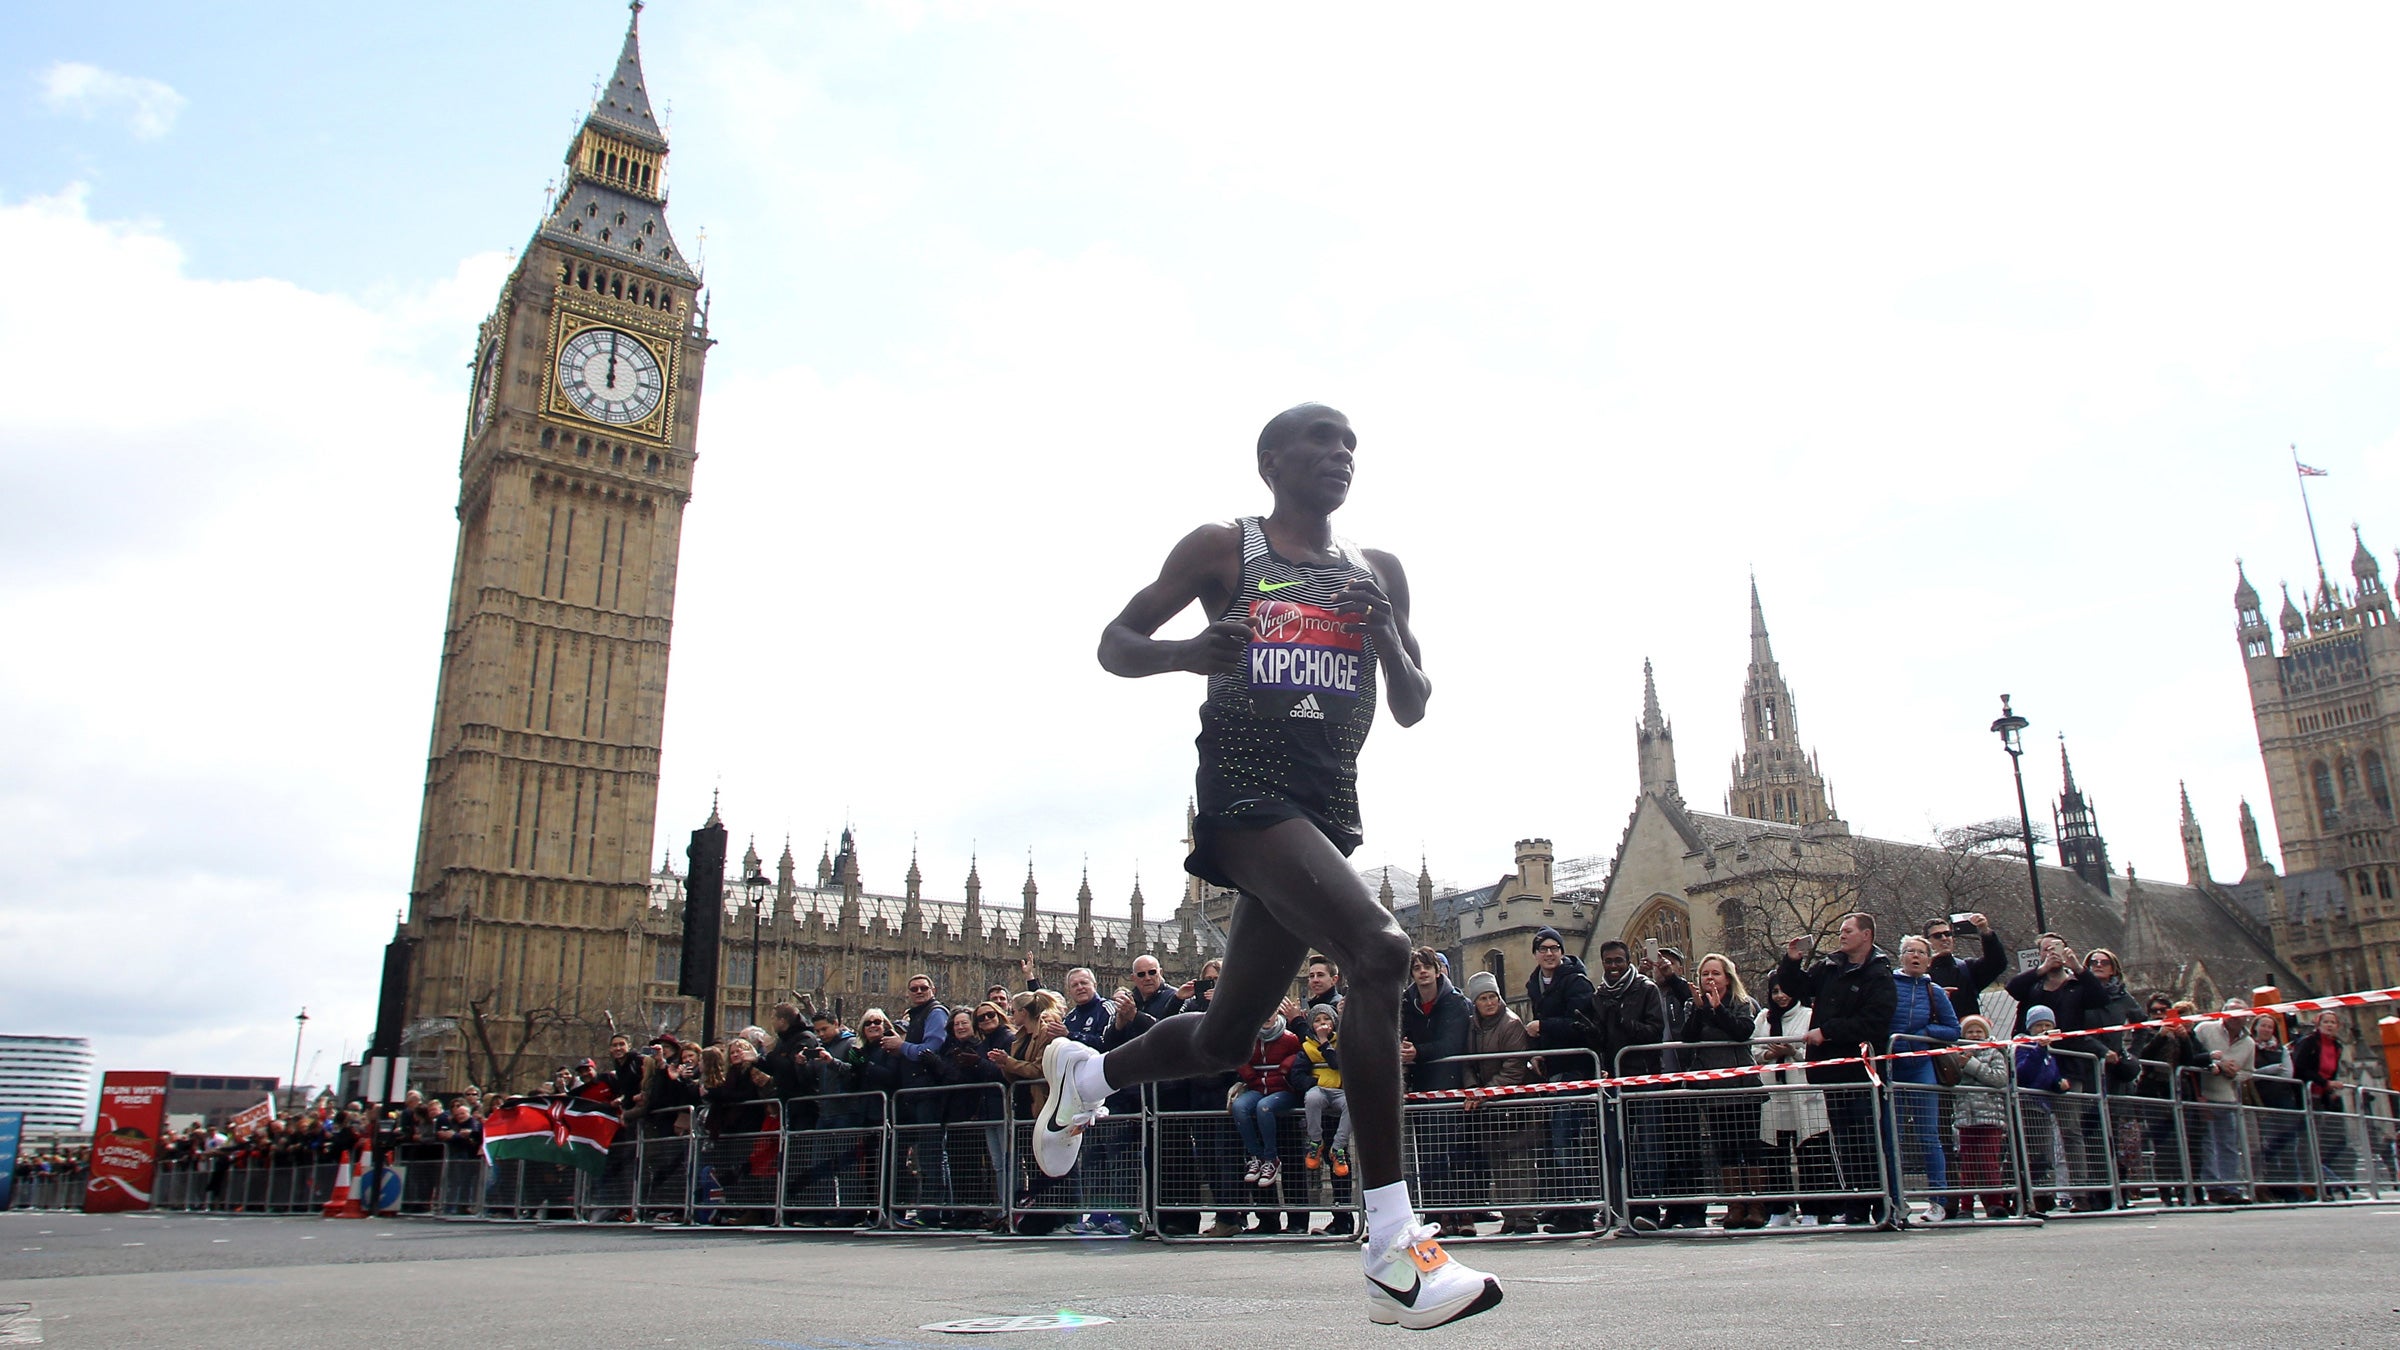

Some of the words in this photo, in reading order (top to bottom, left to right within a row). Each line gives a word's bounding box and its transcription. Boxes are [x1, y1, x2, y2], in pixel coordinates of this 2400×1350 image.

[1260, 601, 1300, 639] Virgin
[1305, 617, 1354, 639] mone
[1252, 648, 1359, 692] KIPCHOGE
[1289, 708, 1325, 720] adidas
[103, 1086, 130, 1095] RUN
[132, 1086, 166, 1095] WITH
[114, 1095, 153, 1104] PRIDE
[97, 1146, 150, 1163] LONDON
[101, 1156, 140, 1169] PRIDE
